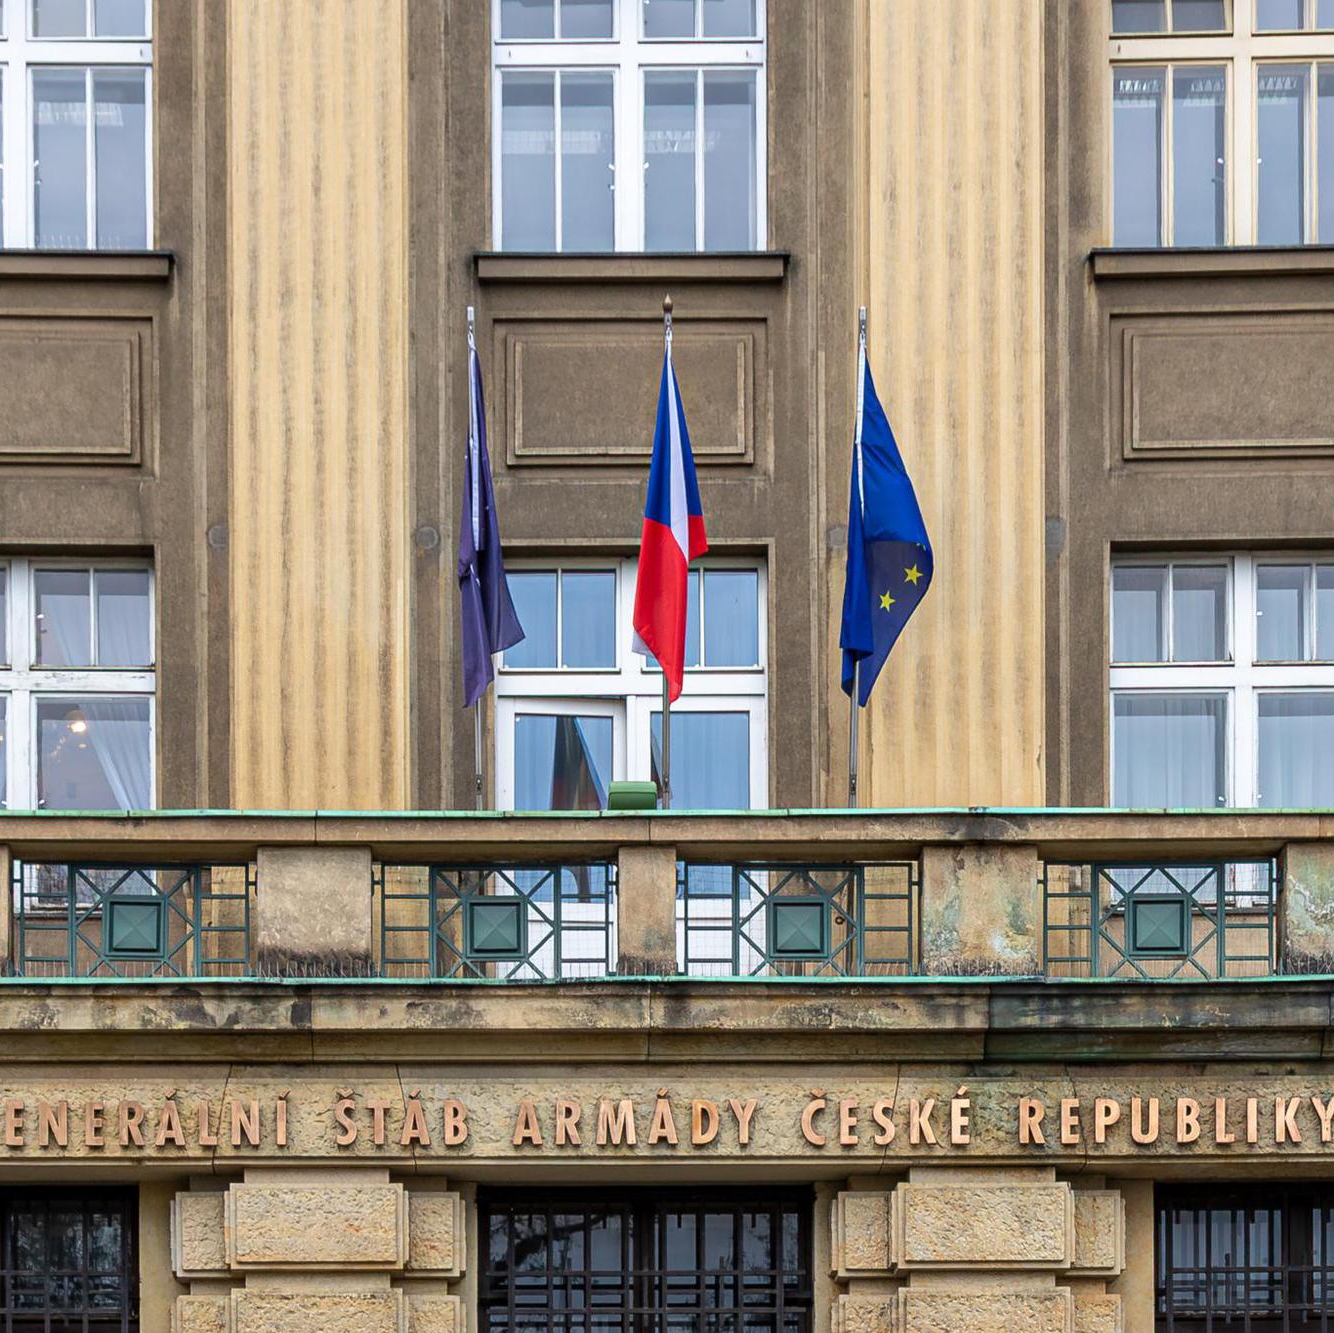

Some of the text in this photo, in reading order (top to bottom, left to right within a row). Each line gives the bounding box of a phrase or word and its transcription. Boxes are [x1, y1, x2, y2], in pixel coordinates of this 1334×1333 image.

[333, 1088, 469, 1148] ŠTÁB
[511, 1087, 759, 1148] ARMÁDY
[800, 1085, 971, 1148] ČESKÉ
